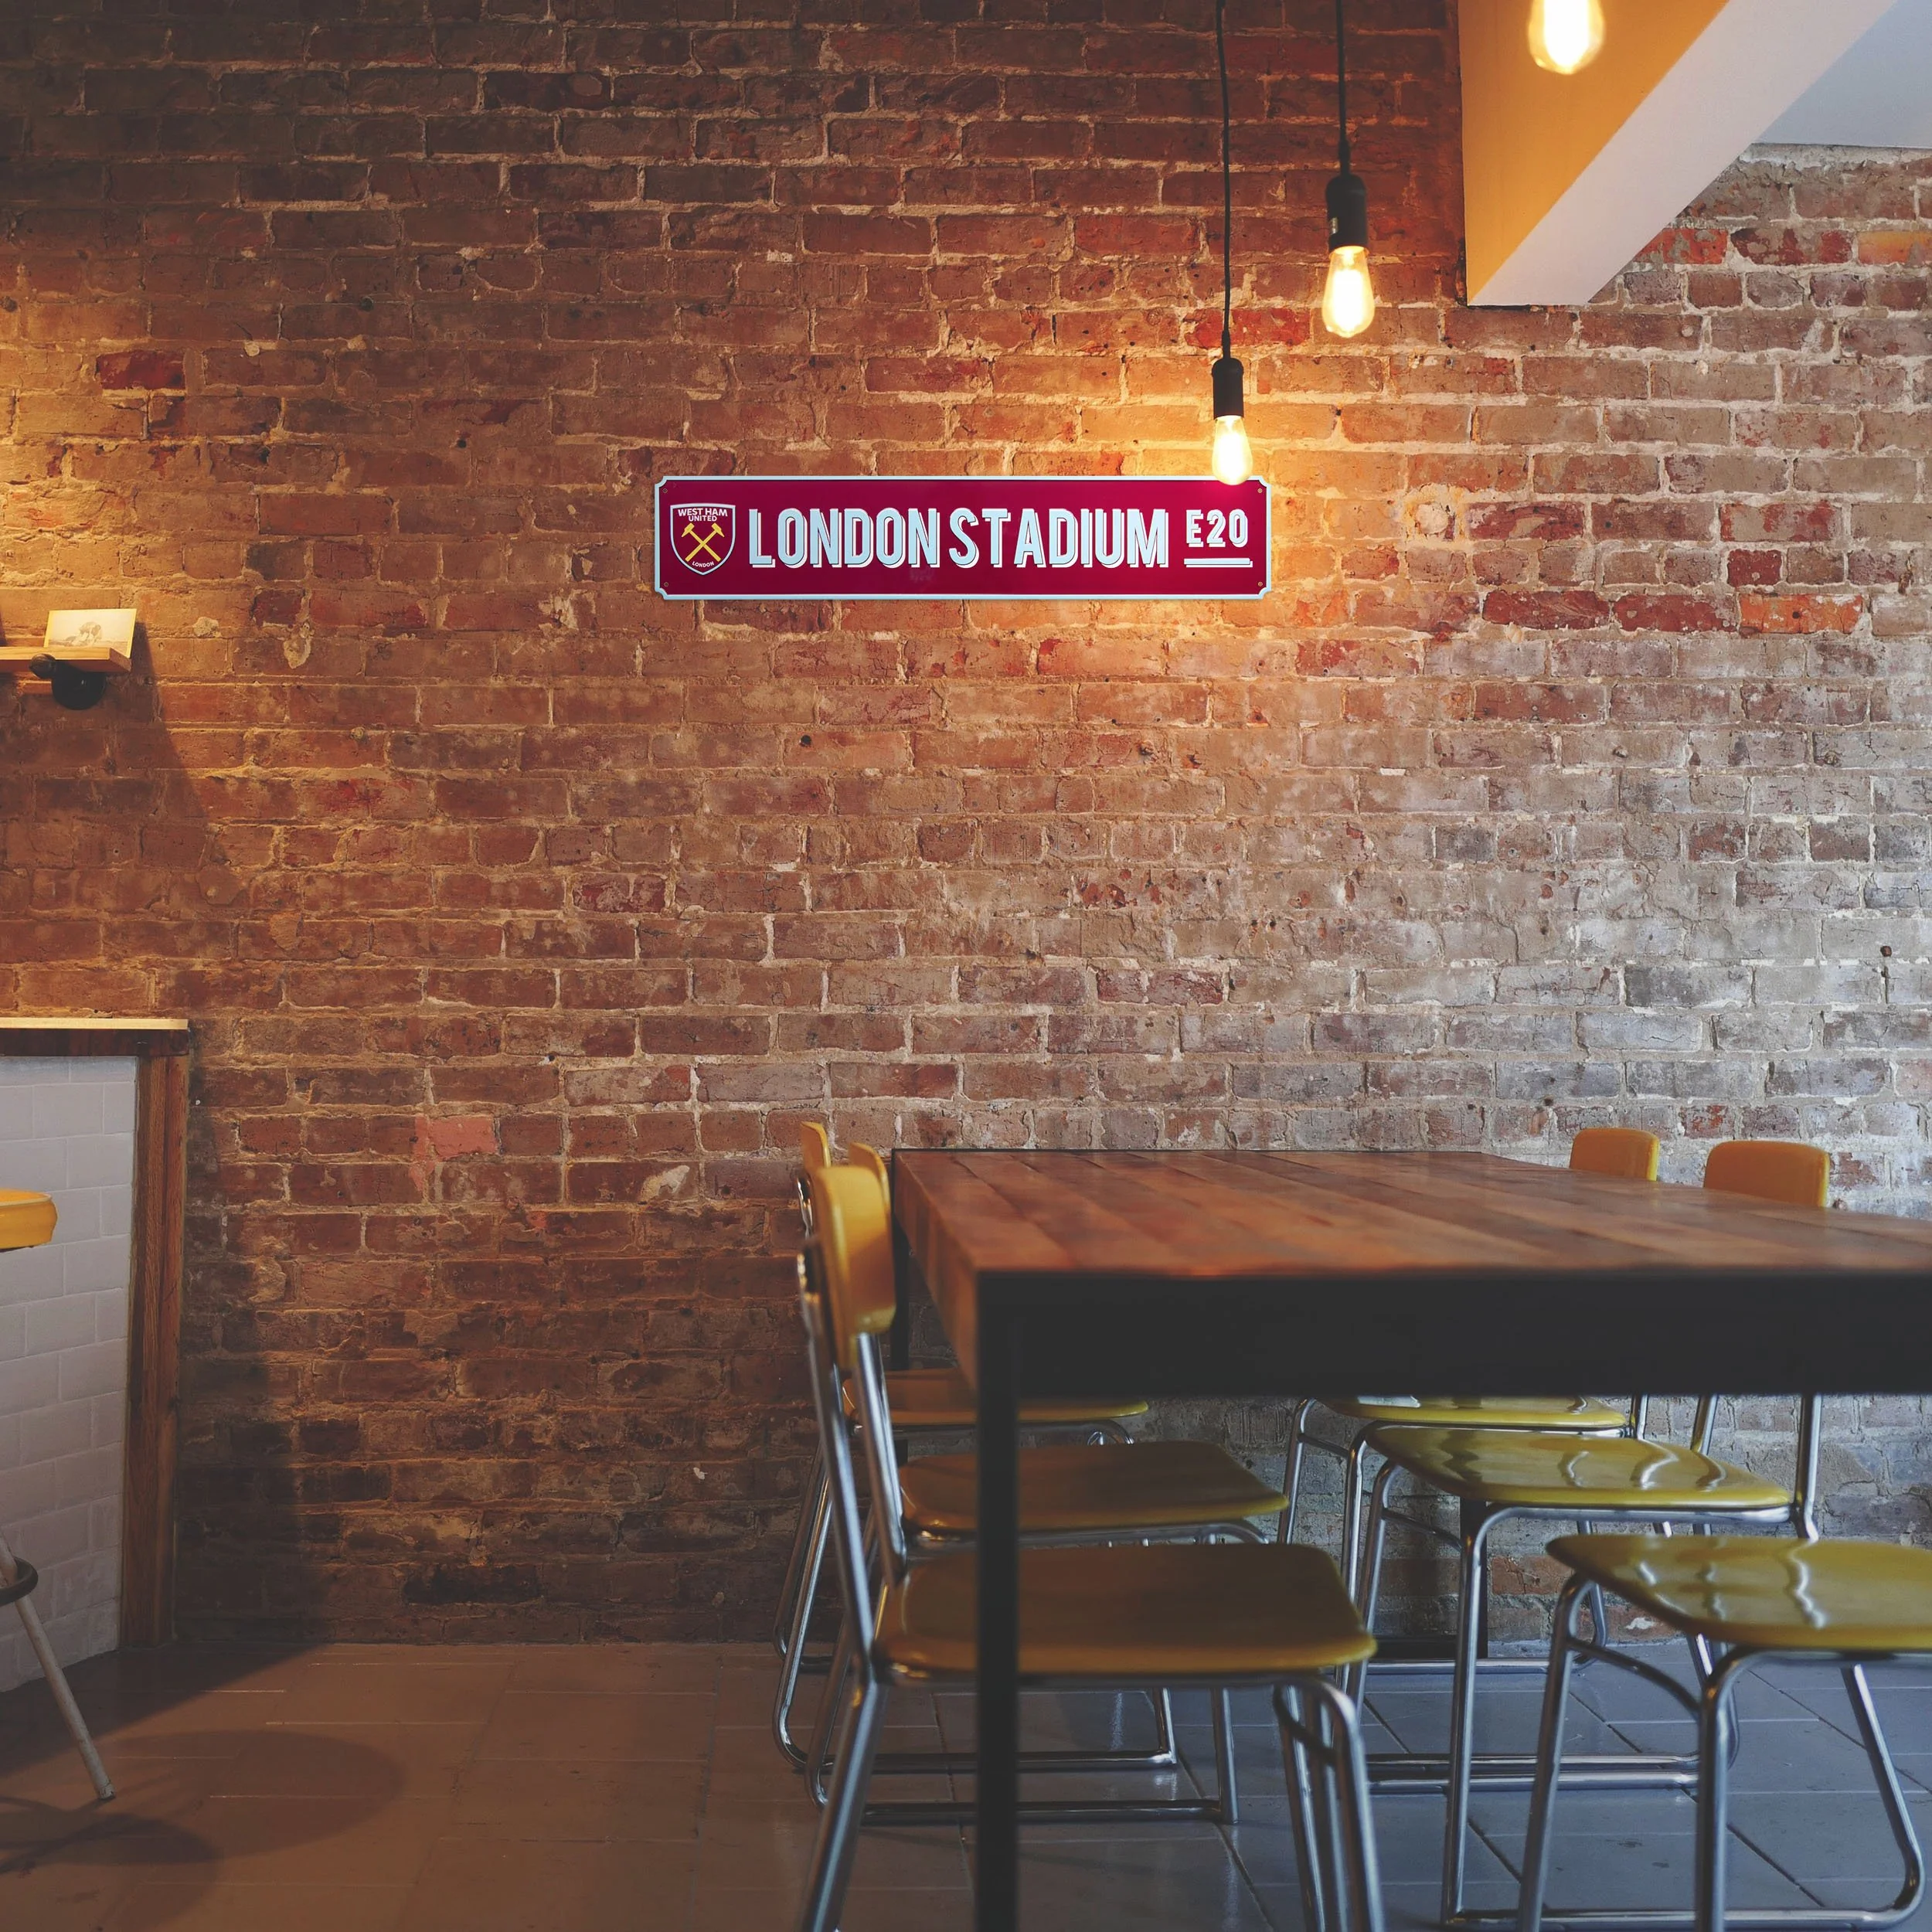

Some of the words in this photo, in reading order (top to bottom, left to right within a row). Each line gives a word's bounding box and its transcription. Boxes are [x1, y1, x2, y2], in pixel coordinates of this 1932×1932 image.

[678, 508, 704, 517] WEST
[705, 508, 728, 517] HAM
[749, 508, 940, 568] LONDON
[949, 508, 1168, 568] STADIUM
[1185, 509, 1248, 548] E20
